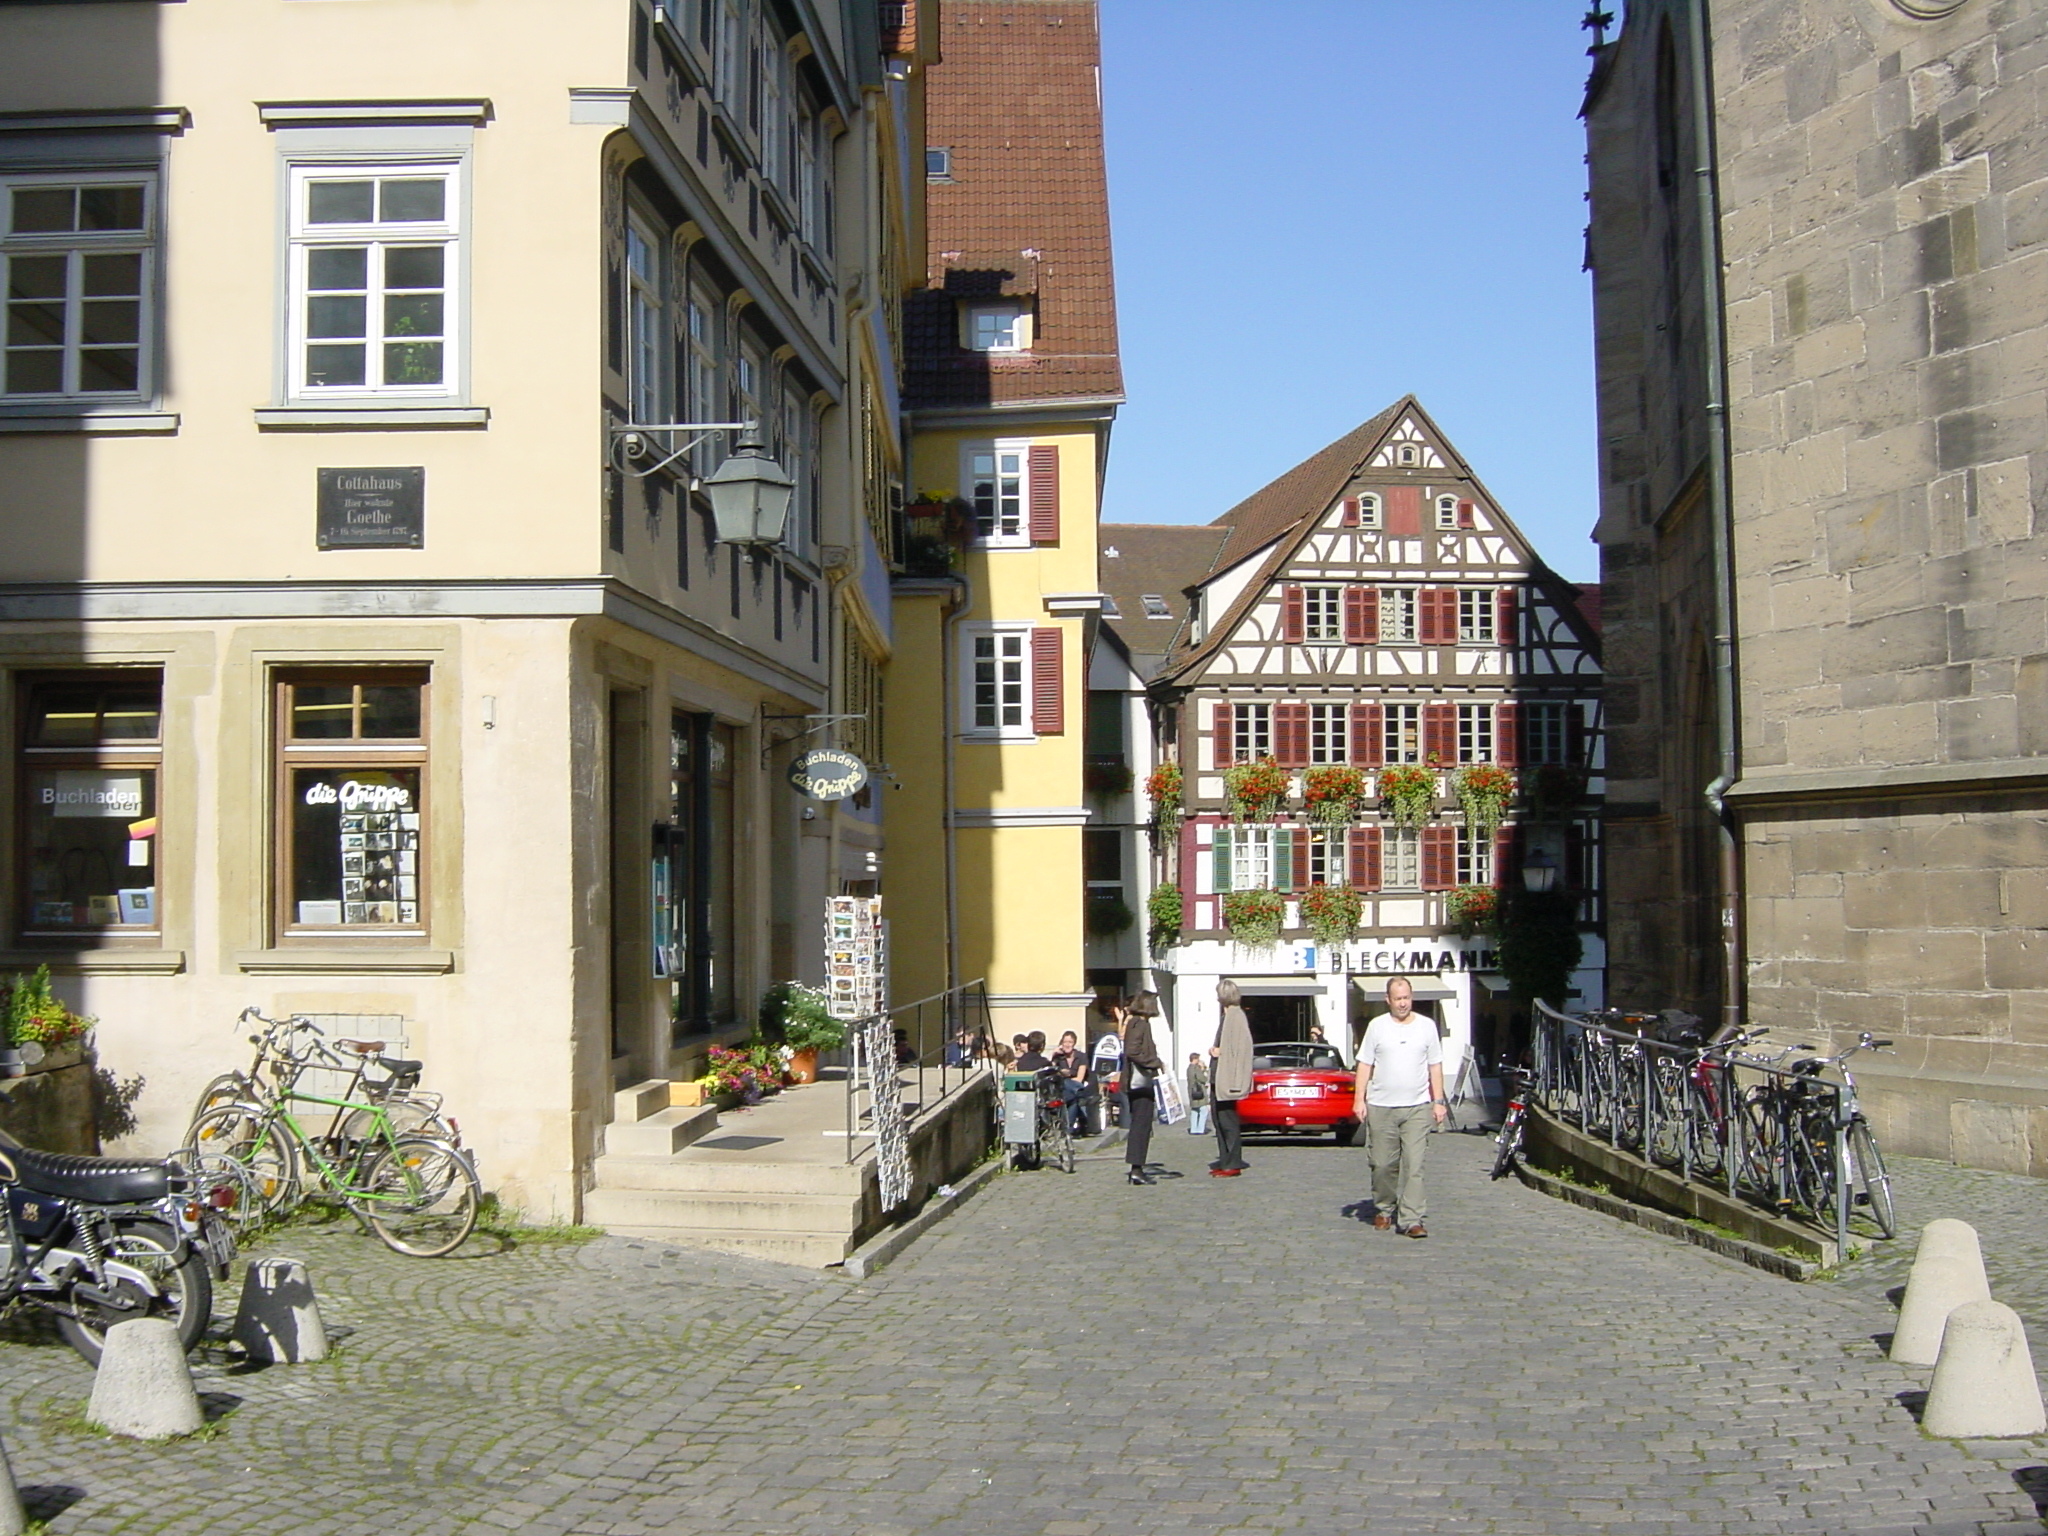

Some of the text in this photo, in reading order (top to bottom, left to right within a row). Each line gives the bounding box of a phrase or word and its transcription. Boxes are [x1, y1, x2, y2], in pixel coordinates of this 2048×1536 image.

[337, 475, 403, 490] Cottahaus
[346, 509, 392, 524] Goethe
[796, 751, 859, 771] Buchladen
[42, 788, 141, 804] Buchladen
[305, 782, 338, 806] die
